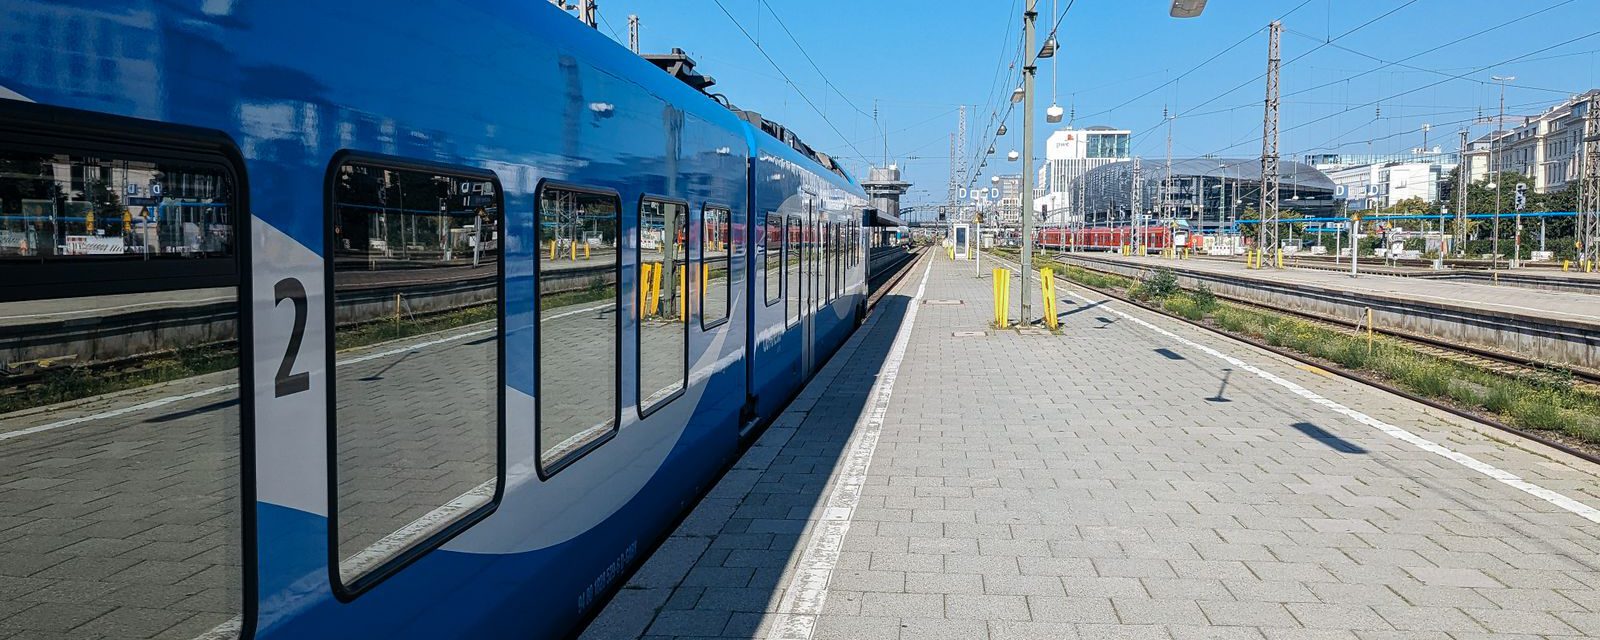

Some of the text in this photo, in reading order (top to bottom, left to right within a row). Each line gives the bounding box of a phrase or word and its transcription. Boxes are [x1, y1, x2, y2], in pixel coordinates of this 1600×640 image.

[959, 189, 967, 198] D
[991, 189, 999, 198] D
[1336, 185, 1344, 196] D
[1371, 185, 1379, 195] D
[274, 277, 309, 398] 2
